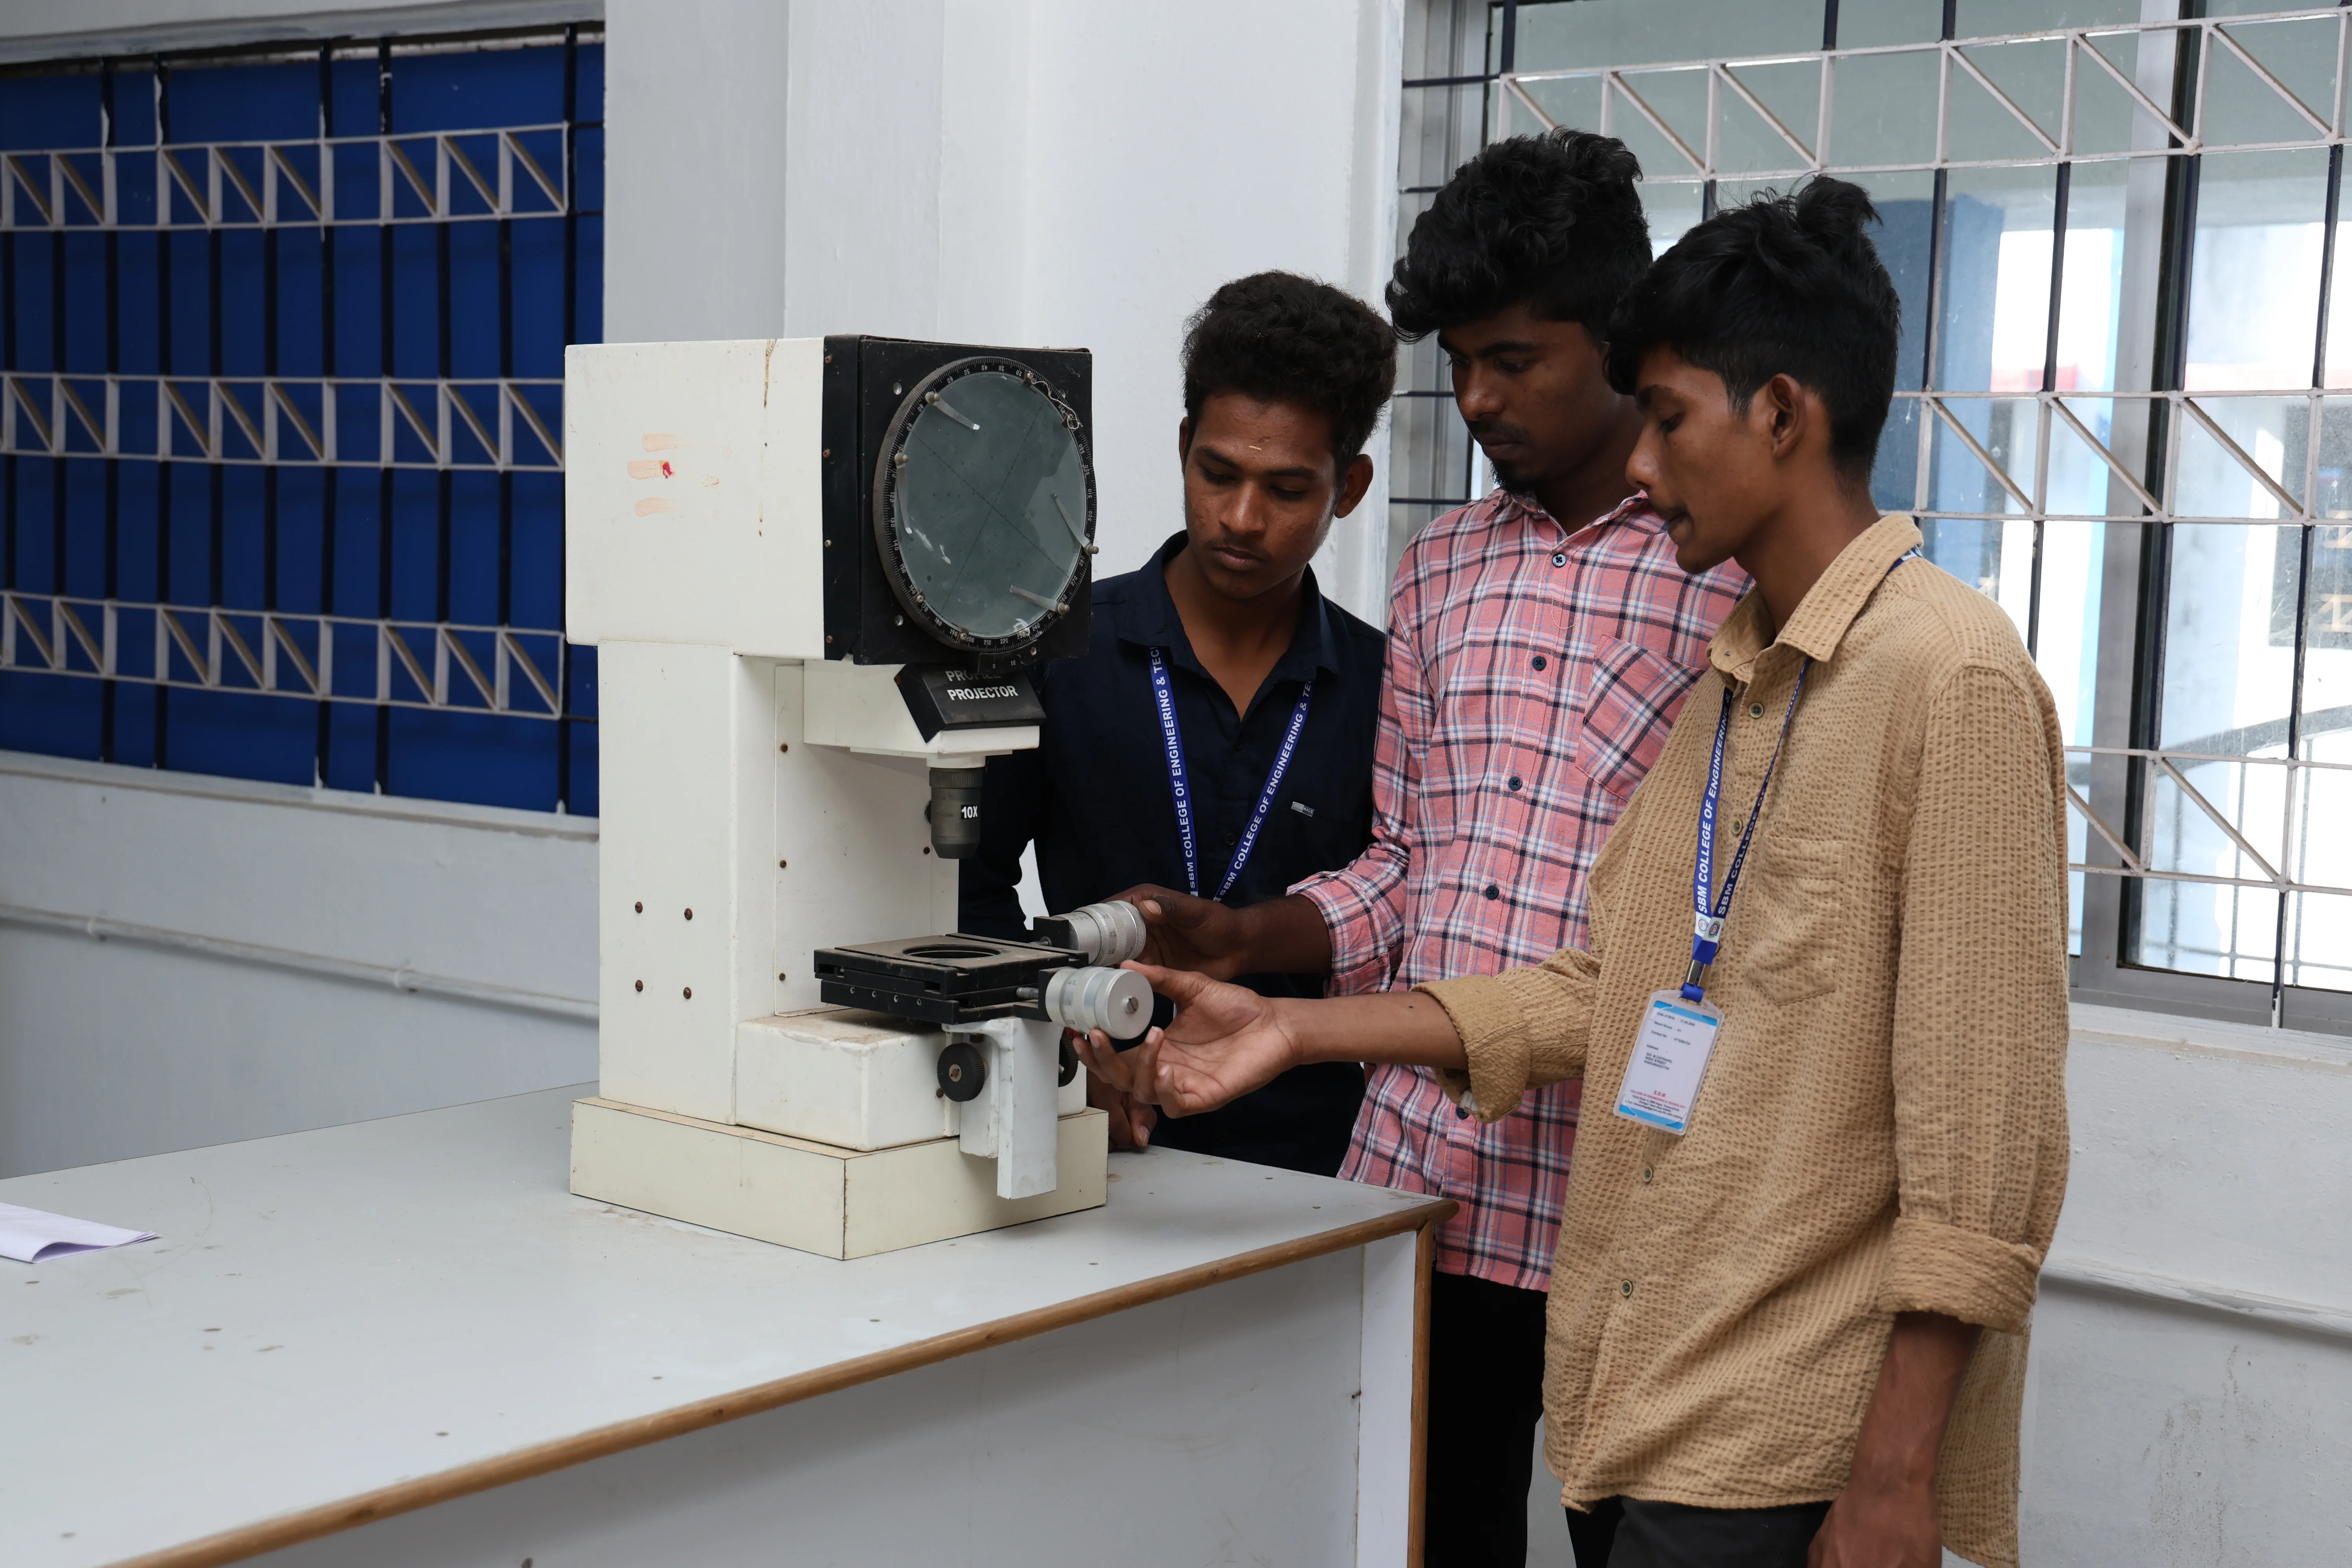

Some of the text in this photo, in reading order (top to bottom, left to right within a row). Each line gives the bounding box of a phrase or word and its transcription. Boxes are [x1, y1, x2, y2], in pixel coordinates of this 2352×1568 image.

[906, 423, 913, 431] 90
[947, 685, 1019, 701] PROJECTOR
[1708, 706, 1727, 799] ENGINEERING
[1150, 647, 1195, 889] SBM COLLEGE OF ENGINEERING & TEC
[961, 805, 978, 819] 10X
[1220, 871, 1237, 896] SBM
[1234, 815, 1262, 869] COLLEGE
[1259, 796, 1269, 813] OF
[1267, 713, 1303, 795] ENGINEERING
[1300, 702, 1307, 711] &
[1294, 804, 1313, 813] ORIGINALS
[1704, 799, 1713, 819] OF
[1698, 820, 1711, 883] COLLEGE
[1718, 883, 1733, 915] SBM
[1731, 811, 1758, 879] COLLEGE
[1697, 885, 1707, 914] SBM
